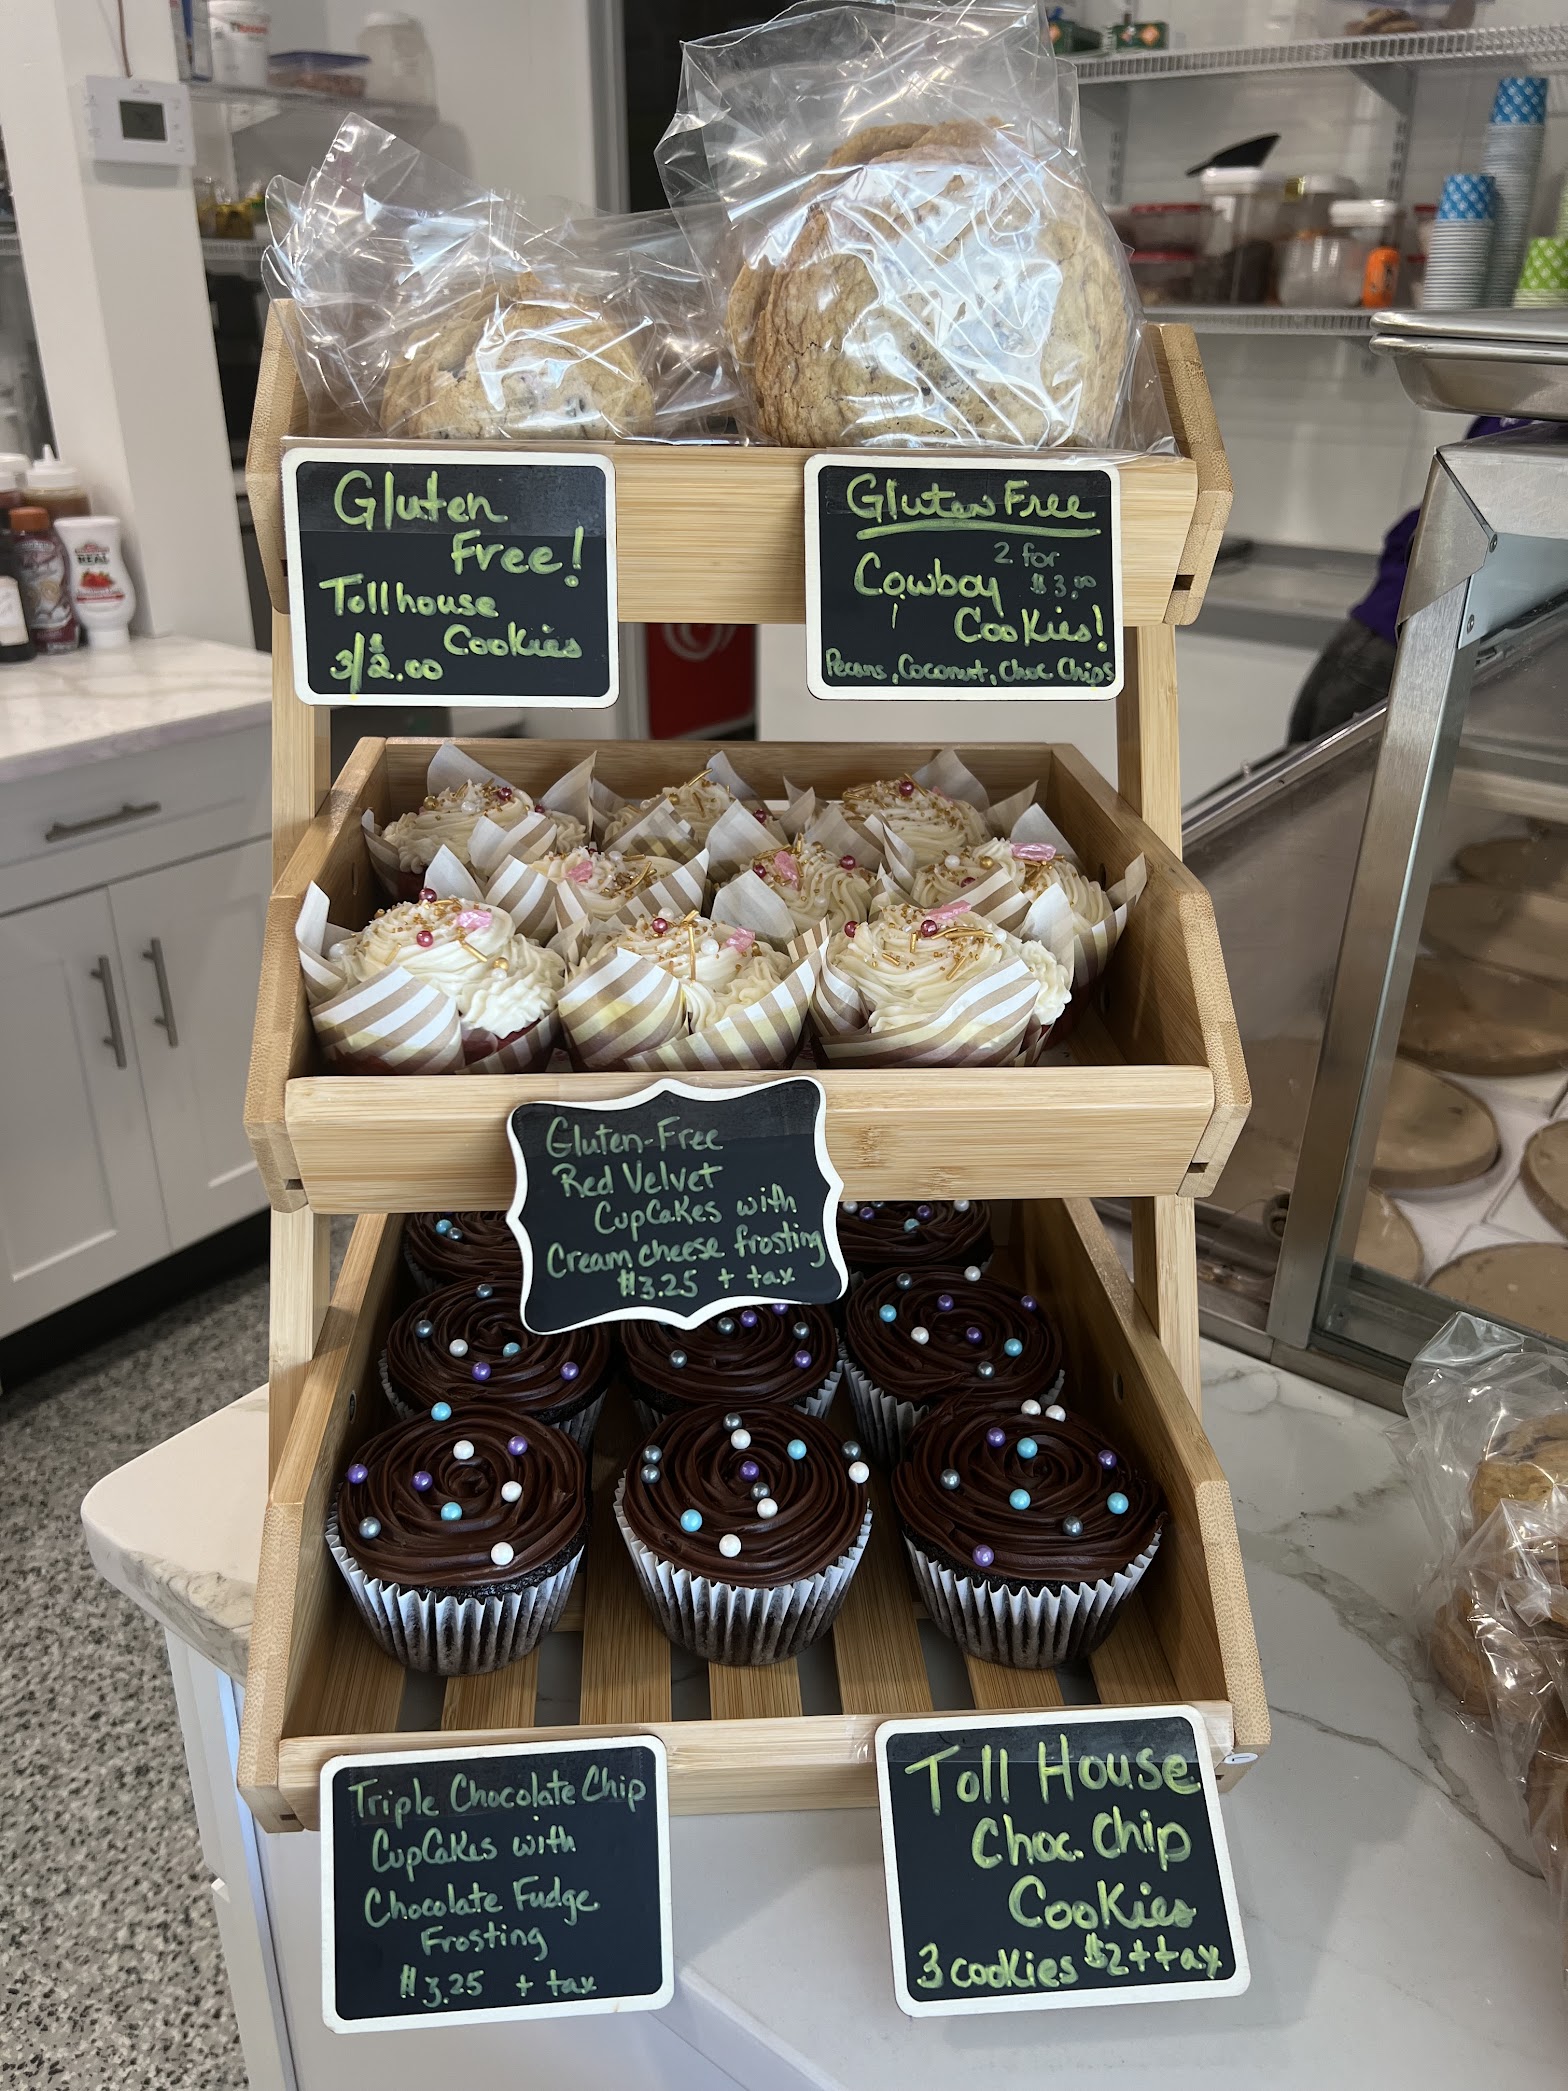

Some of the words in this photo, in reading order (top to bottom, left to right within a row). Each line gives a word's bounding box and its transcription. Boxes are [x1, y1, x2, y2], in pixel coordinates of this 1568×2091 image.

[334, 469, 508, 530] Gluten
[847, 473, 995, 523] Gluten
[1004, 480, 1096, 519] Free
[452, 525, 584, 587] Free!
[994, 542, 1014, 564] 2
[1022, 542, 1060, 568] for
[854, 551, 1004, 619] Cowboy
[444, 621, 583, 658] Cookies
[954, 604, 1108, 652] Cookies!
[999, 658, 1054, 682] Choc
[1057, 657, 1116, 690] Chips
[546, 1116, 724, 1158] Gluten-Free
[552, 1163, 614, 1198] Red
[622, 1160, 724, 1193] Velvet
[737, 1183, 797, 1216] with
[547, 1242, 633, 1278] Cream
[638, 1237, 726, 1268] cheese
[734, 1221, 826, 1268] frosting
[617, 1269, 698, 1300] $3.25
[718, 1268, 735, 1289] +
[747, 1264, 796, 1289] tax
[348, 1777, 440, 1830] Triple
[449, 1768, 576, 1812] Chocolate
[581, 1764, 647, 1812] Chip
[904, 1744, 1010, 1817] Toll
[1038, 1733, 1202, 1804] House
[513, 1815, 577, 1857] with
[971, 1813, 1085, 1869] Choc.
[1092, 1805, 1192, 1872] Chip
[364, 1882, 503, 1928] Chocolate
[513, 1875, 600, 1926] Fudge
[1008, 1874, 1197, 1931] Cookies
[420, 1920, 549, 1961] Frosting
[516, 1974, 534, 1997] +
[546, 1968, 598, 1997] tax
[917, 1942, 944, 1988] 3
[950, 1948, 1079, 1988] cookies
